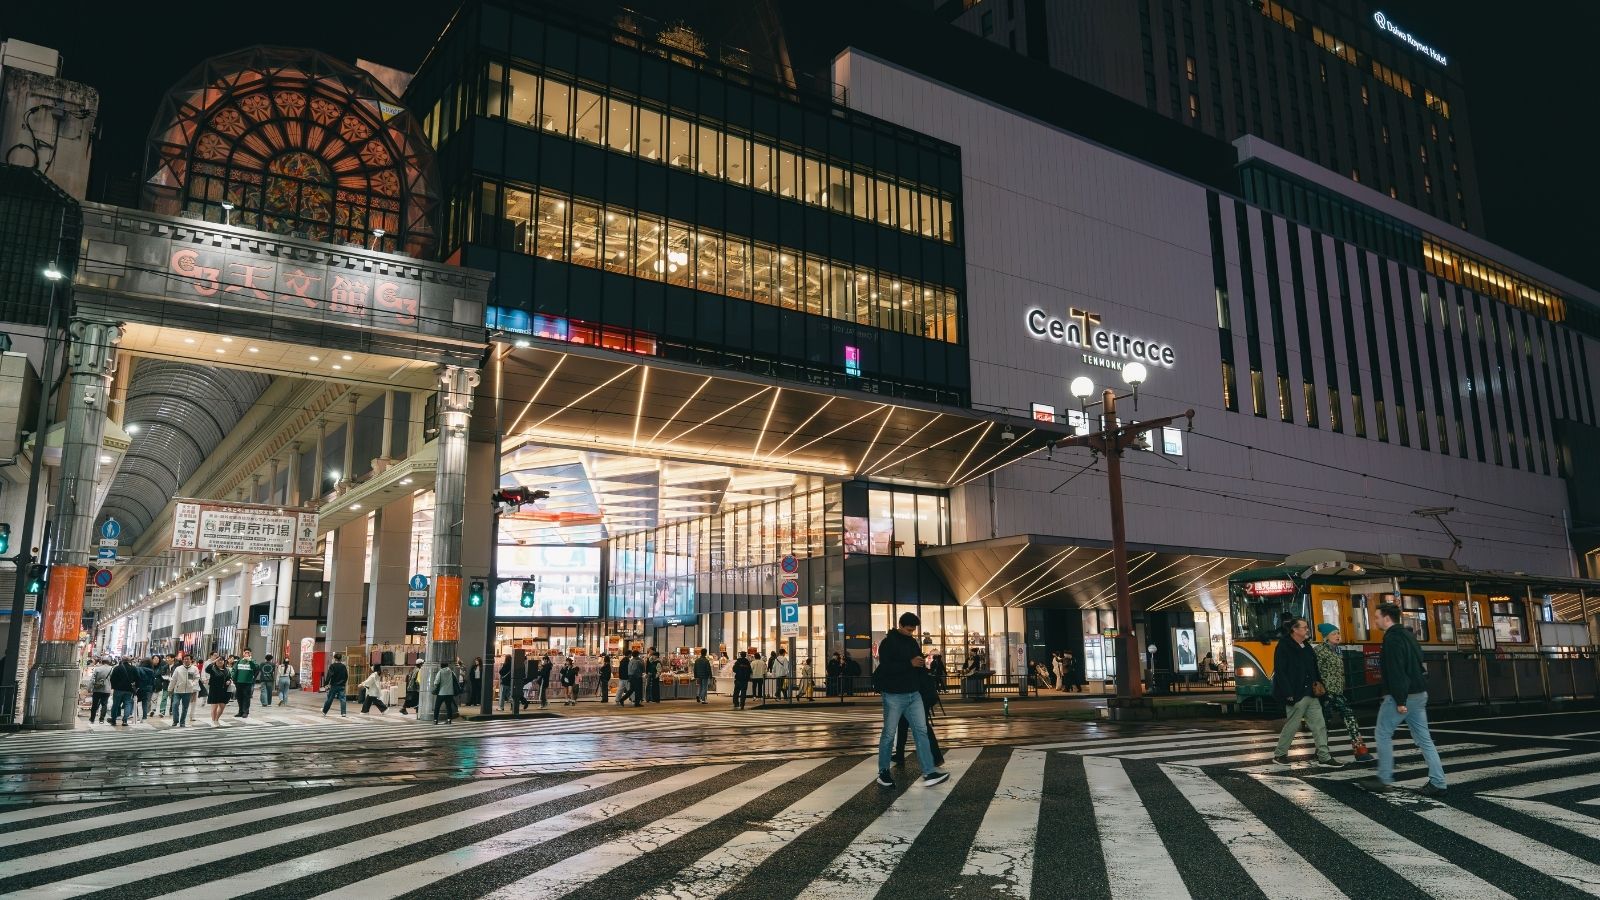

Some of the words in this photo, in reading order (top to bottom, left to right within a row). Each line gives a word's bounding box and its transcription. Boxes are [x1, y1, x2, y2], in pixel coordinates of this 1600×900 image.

[1386, 20, 1407, 41] Daiwa
[1406, 33, 1430, 56] Roynet
[1429, 47, 1447, 66] Hotel
[223, 263, 370, 320] 天文館
[1027, 307, 1175, 365] CenTerrace
[233, 521, 290, 537] 東京市場
[1245, 582, 1254, 595] 2
[785, 605, 796, 622] P
